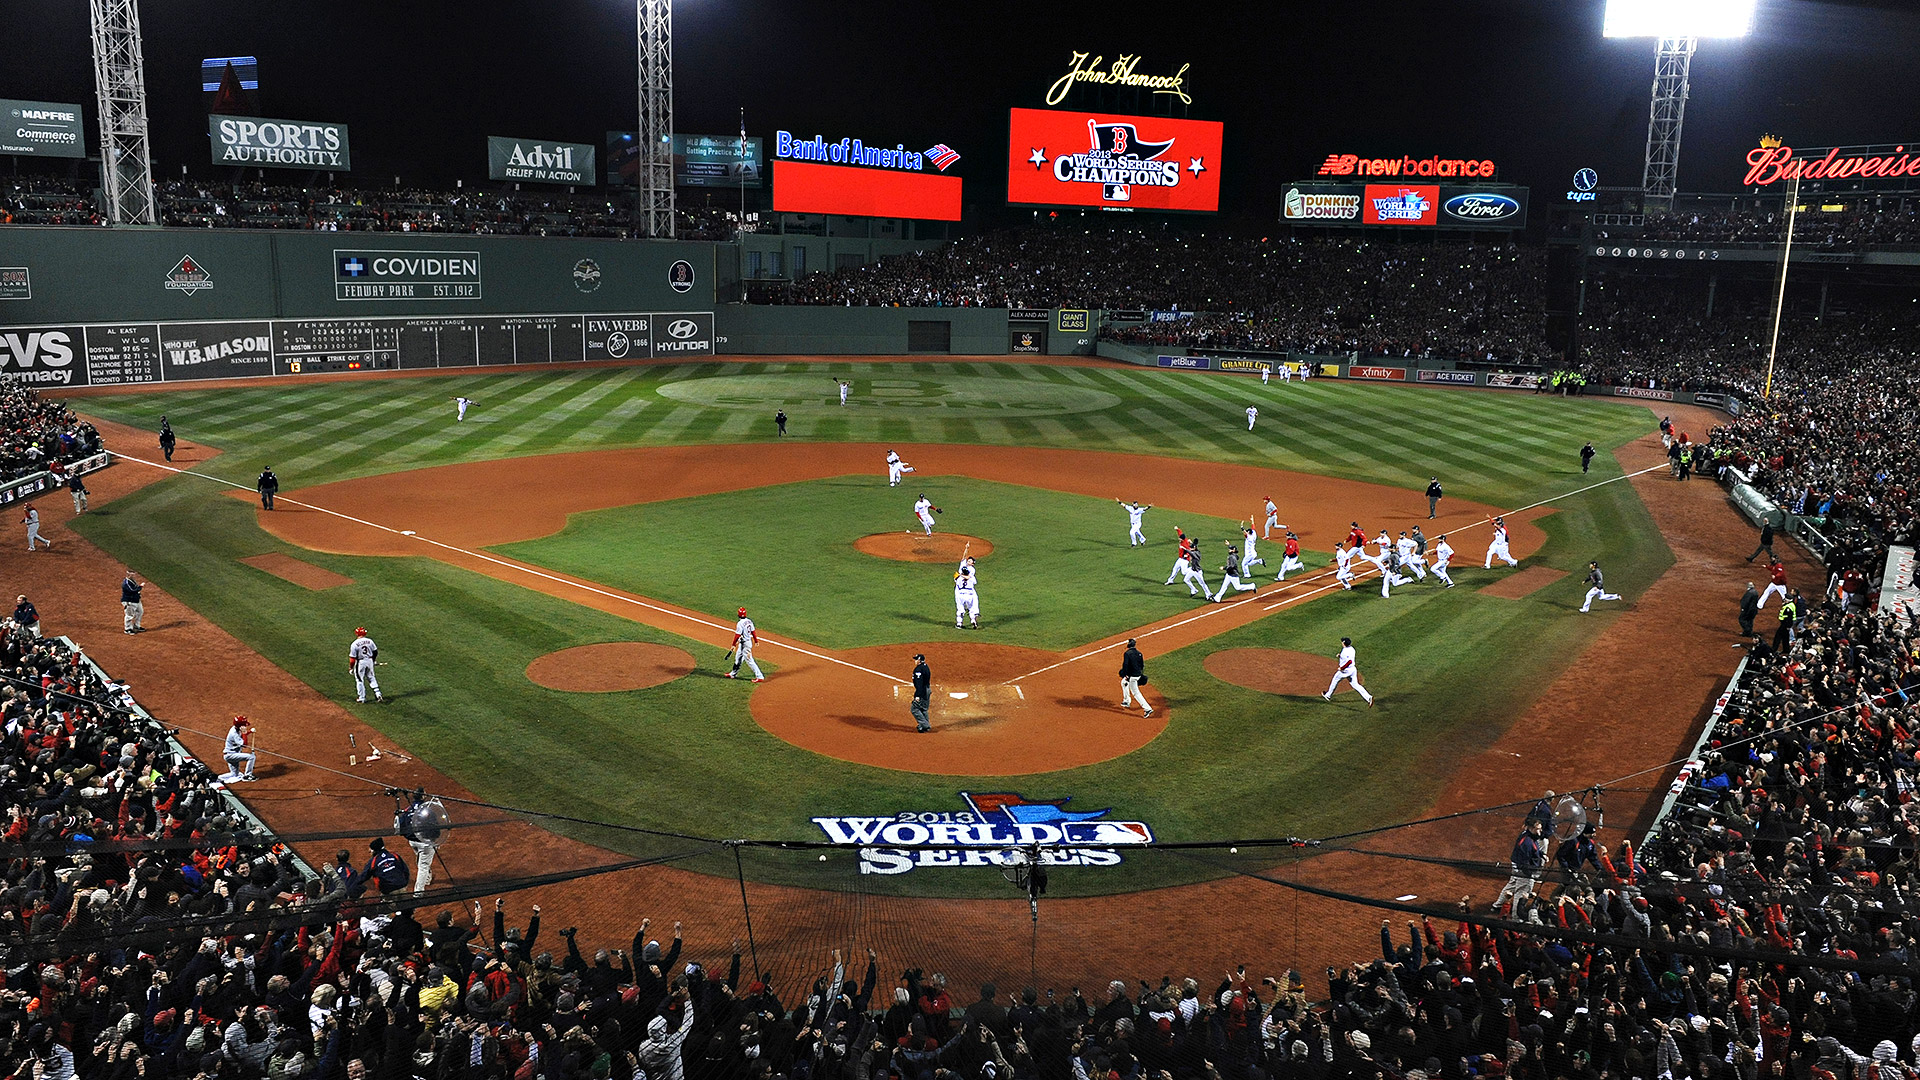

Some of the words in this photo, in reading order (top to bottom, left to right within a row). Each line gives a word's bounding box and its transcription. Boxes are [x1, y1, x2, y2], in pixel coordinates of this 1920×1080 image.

[1046, 51, 1112, 105] John
[1109, 53, 1191, 104] Hancock
[22, 109, 75, 121] MAPFRE
[17, 128, 76, 140] Commerce
[220, 120, 341, 150] SPORTS
[223, 146, 339, 165] AUTHORITY
[508, 143, 573, 169] Advil
[776, 130, 828, 161] Bank
[829, 137, 850, 163] of
[850, 139, 923, 170] America
[1089, 149, 1112, 159] 2013
[1073, 153, 1118, 168] WORLD
[1118, 155, 1163, 171] SERIES
[506, 168, 534, 178] RELIEF
[536, 170, 546, 179] IN
[548, 170, 581, 181] ACTION
[1054, 156, 1180, 187] CHAMPIONS
[1305, 195, 1360, 207] DUNKIN'
[1372, 198, 1415, 211] WORLD
[1305, 206, 1355, 218] DONUTS
[1458, 198, 1504, 218] Ford
[1378, 209, 1422, 221] SERIES
[373, 258, 477, 275] COVIDIEN
[2, 271, 26, 282] SOX
[345, 285, 384, 297] FENWAY
[390, 285, 415, 297] PARK
[433, 285, 452, 296] EST.
[454, 285, 473, 296] 1912
[1062, 312, 1084, 321] GIANT
[611, 319, 648, 332] WEBB
[1061, 320, 1085, 329] GLASS
[163, 341, 182, 350] WHO
[182, 340, 197, 349] BUT
[588, 340, 604, 349] Since
[633, 339, 648, 347] 1866
[656, 340, 709, 352] HYUNDAI
[90, 361, 122, 369] BALTIMORE
[290, 361, 301, 373] 13
[1170, 358, 1197, 367] jetBlue
[1221, 360, 1254, 369] GRANITE
[1, 369, 73, 384] armacy
[1362, 368, 1392, 379] xfinity
[1451, 373, 1474, 381] TICKET
[91, 376, 121, 384] TORONTO
[361, 645, 368, 655] 3
[898, 811, 975, 824] 2013
[811, 817, 1064, 845] WORLD
